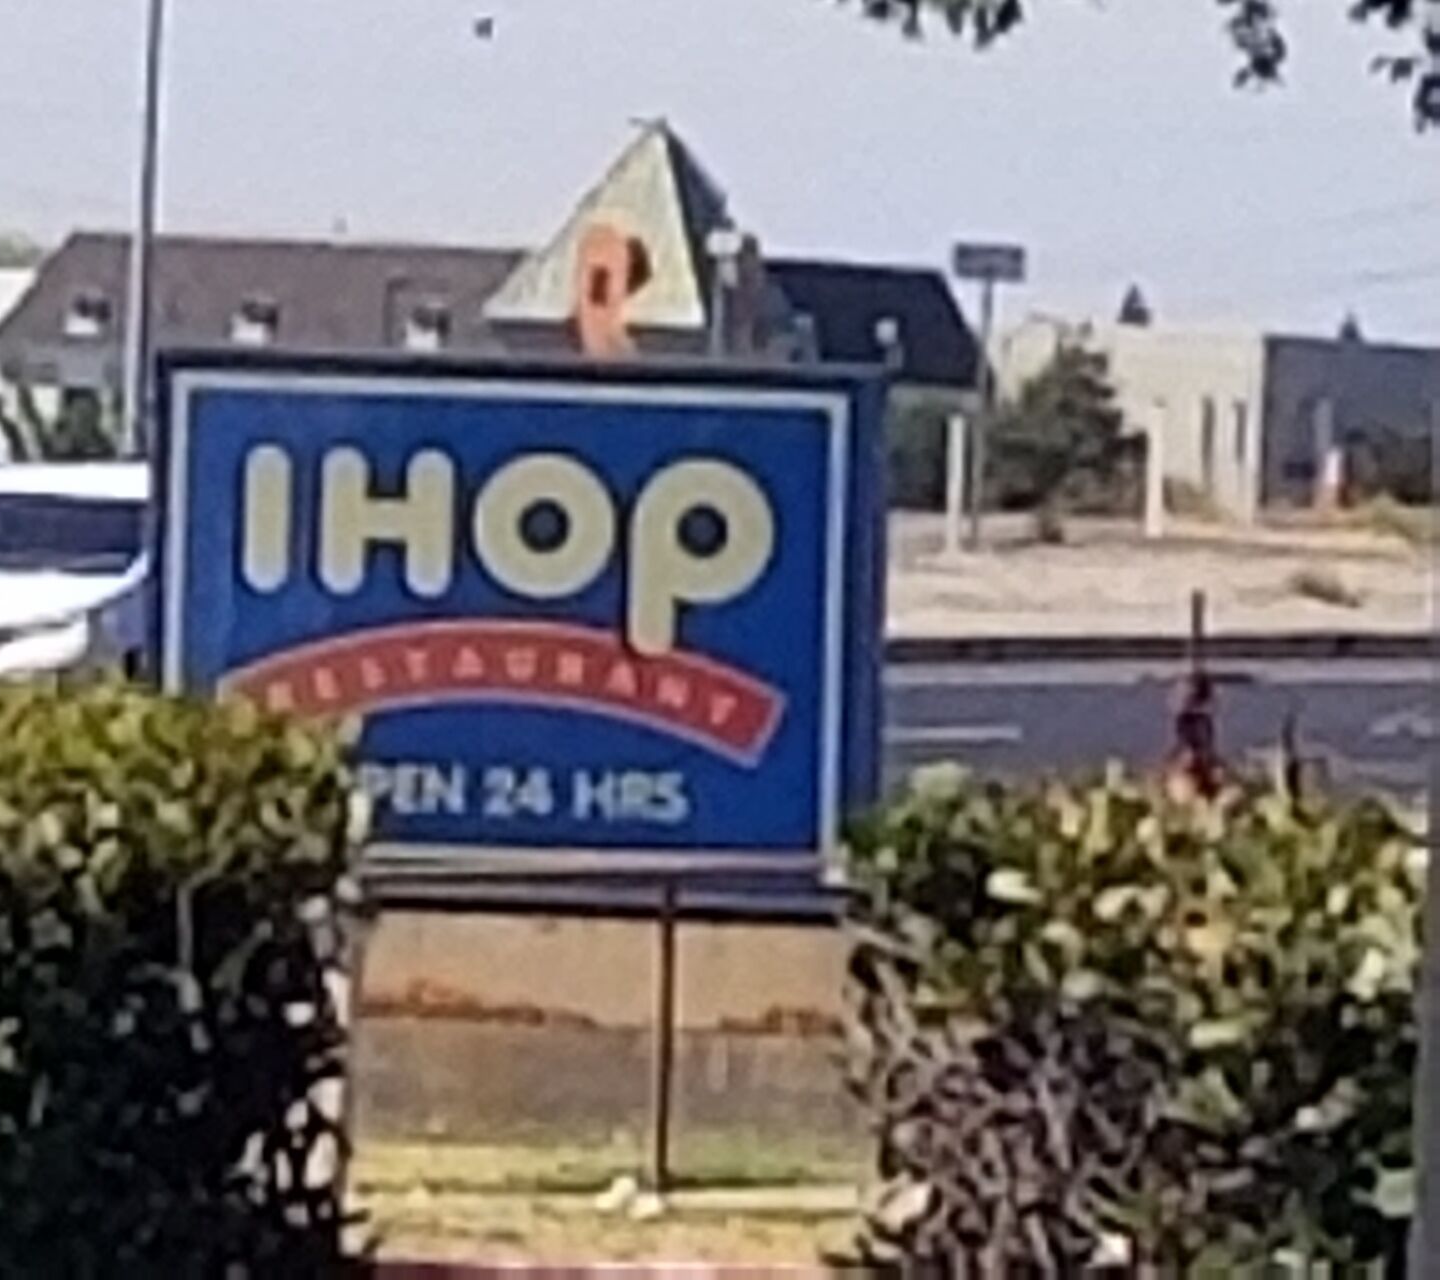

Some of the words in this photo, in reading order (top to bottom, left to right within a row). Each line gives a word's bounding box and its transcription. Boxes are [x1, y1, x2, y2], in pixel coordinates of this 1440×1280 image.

[241, 444, 776, 657] IHOP
[340, 762, 466, 816] PEN
[481, 765, 554, 819] 24
[572, 768, 691, 826] HRS
